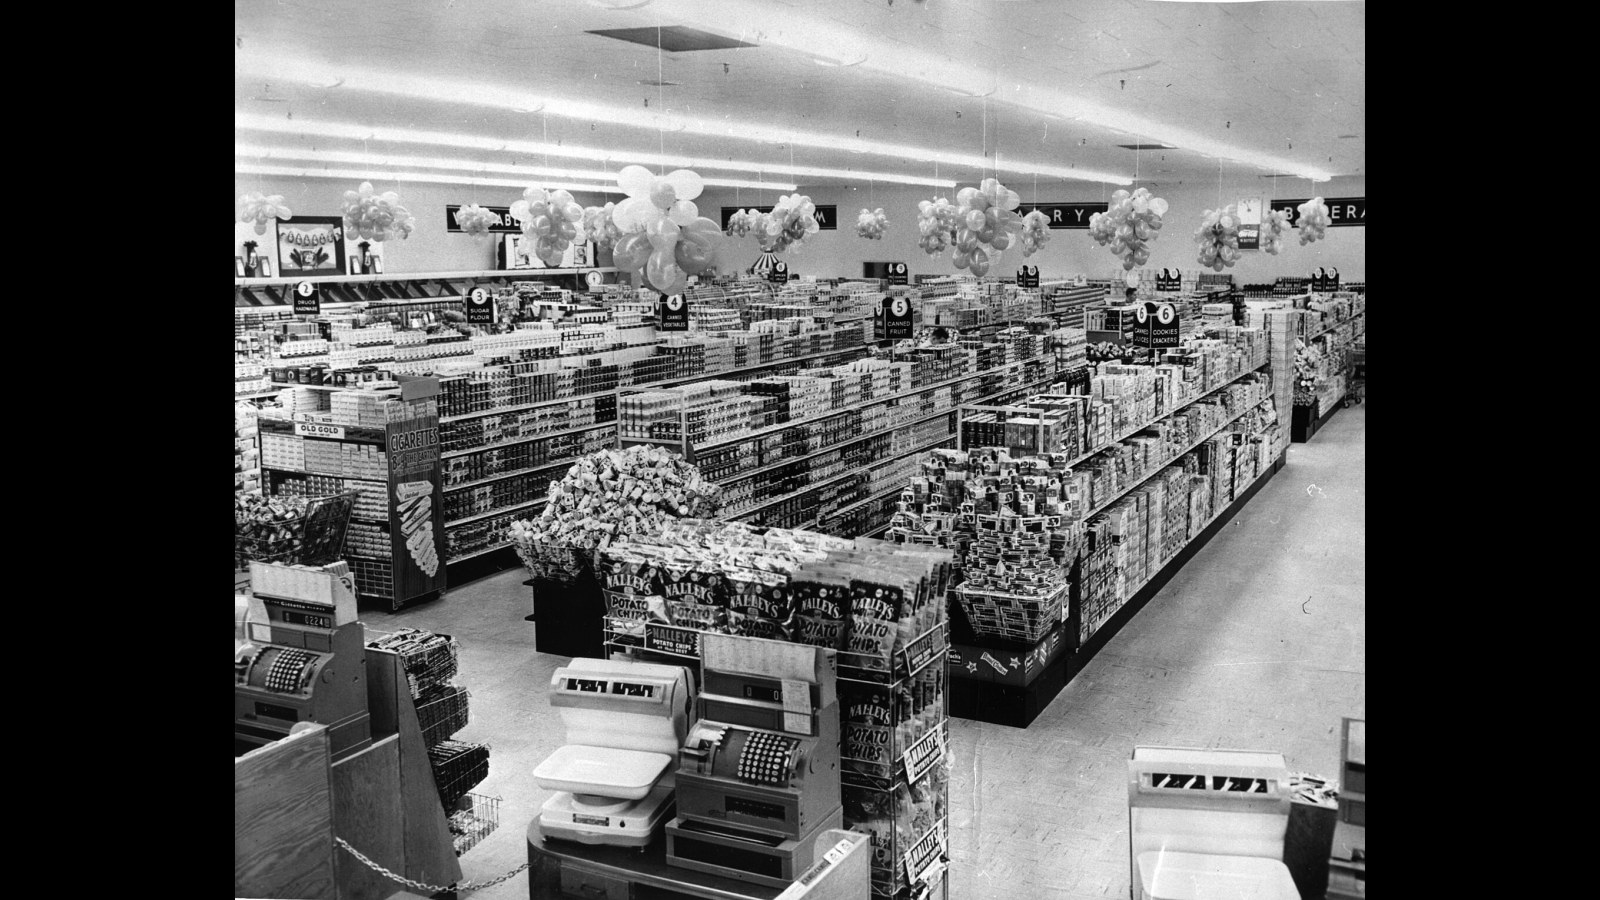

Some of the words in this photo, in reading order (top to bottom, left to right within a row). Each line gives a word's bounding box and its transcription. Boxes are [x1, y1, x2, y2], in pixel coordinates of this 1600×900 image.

[303, 284, 309, 293] 2
[477, 291, 483, 301] 3
[671, 297, 678, 307] 4
[897, 301, 903, 313] 5
[1139, 307, 1144, 319] 6
[1162, 308, 1169, 320] 6
[1152, 328, 1178, 336] COOKIES
[1152, 336, 1177, 344] CRACKERS
[301, 425, 316, 433] OLD
[318, 426, 339, 434] GOLD
[390, 427, 438, 452] CIGARETTES
[418, 448, 437, 462] CARTON
[281, 601, 305, 609] Gillette
[611, 595, 649, 611] POTATO
[730, 594, 779, 618] NALLEY'S
[801, 597, 840, 619] NALLEY'S
[851, 597, 895, 620] NALLEY'S
[617, 609, 648, 621] CHIPS
[671, 604, 711, 619] POTATO
[676, 619, 709, 631] CHIPS
[735, 616, 774, 632] POTATO
[652, 638, 674, 648] POTATO
[675, 642, 692, 651] CHIPS
[849, 704, 890, 725] NALLEY'S
[848, 726, 889, 744] POTATO
[850, 744, 883, 760] CHIPS
[914, 756, 930, 775] POTATO
[929, 746, 940, 762] CHIPS
[915, 854, 930, 876] POTATO
[929, 844, 941, 861] CHIPS
